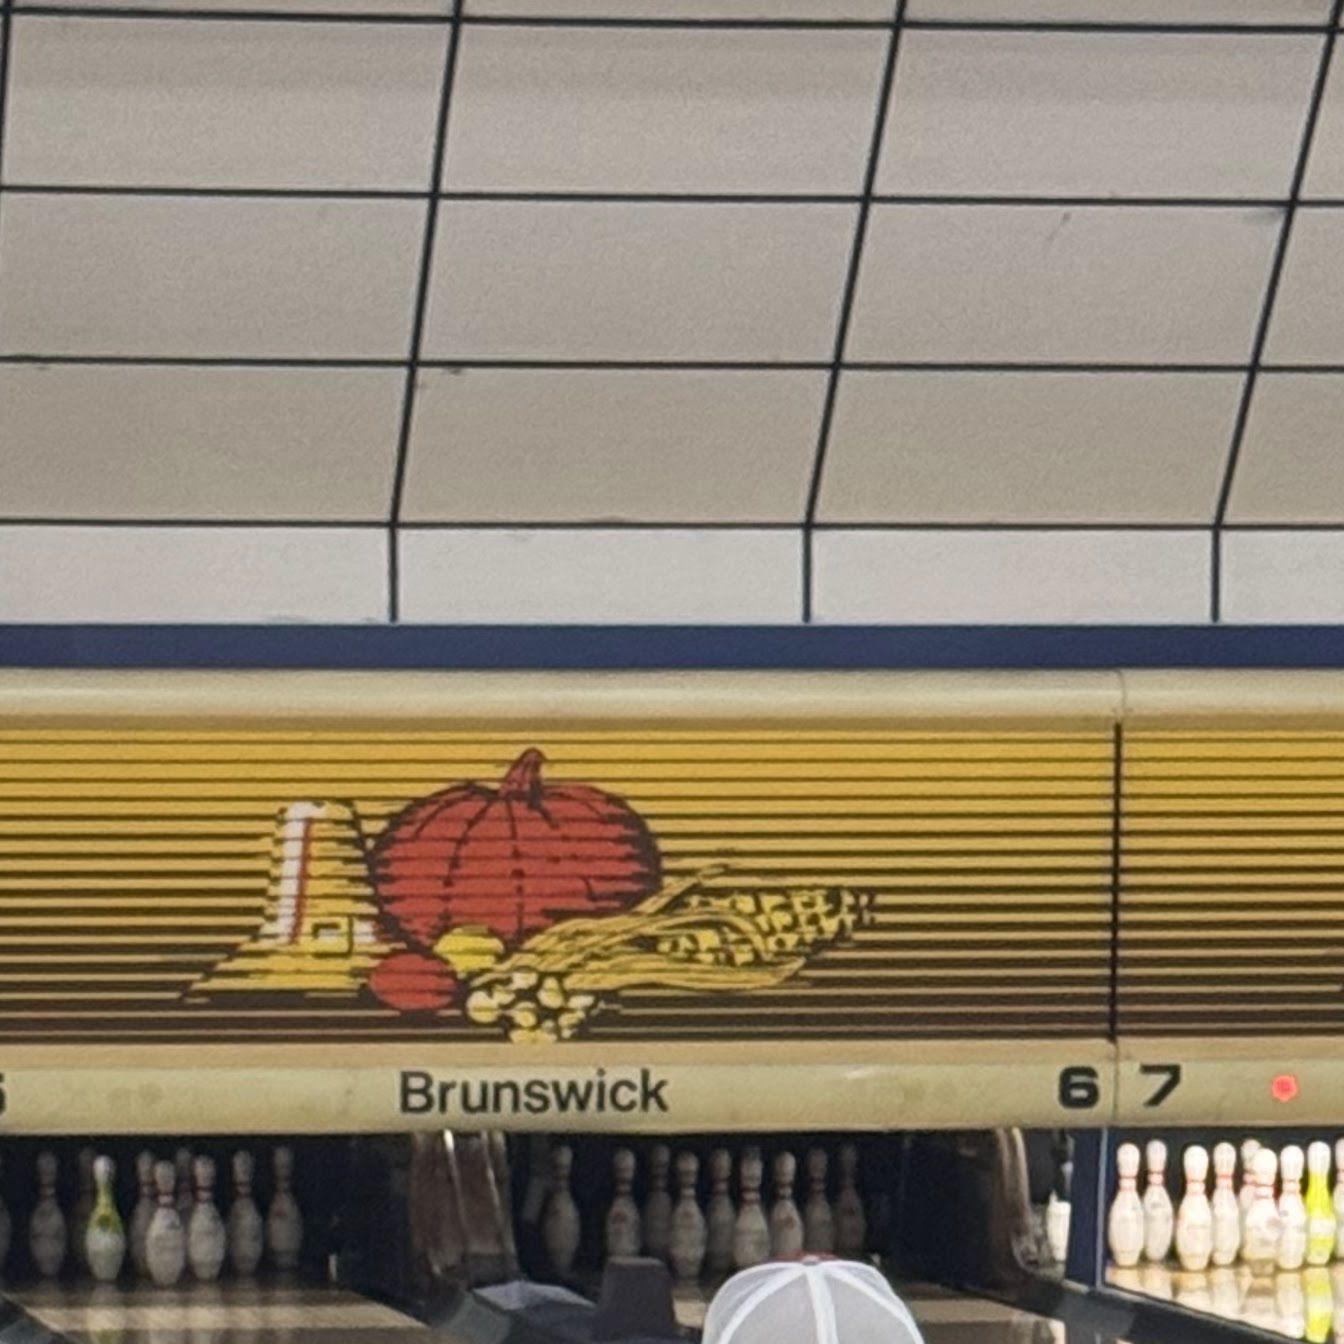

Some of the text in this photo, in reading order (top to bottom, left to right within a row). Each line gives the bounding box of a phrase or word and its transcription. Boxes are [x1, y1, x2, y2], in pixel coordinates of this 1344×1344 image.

[400, 1068, 669, 1114] Brunswick
[1058, 1066, 1099, 1109] 6
[1139, 1065, 1181, 1107] 7
